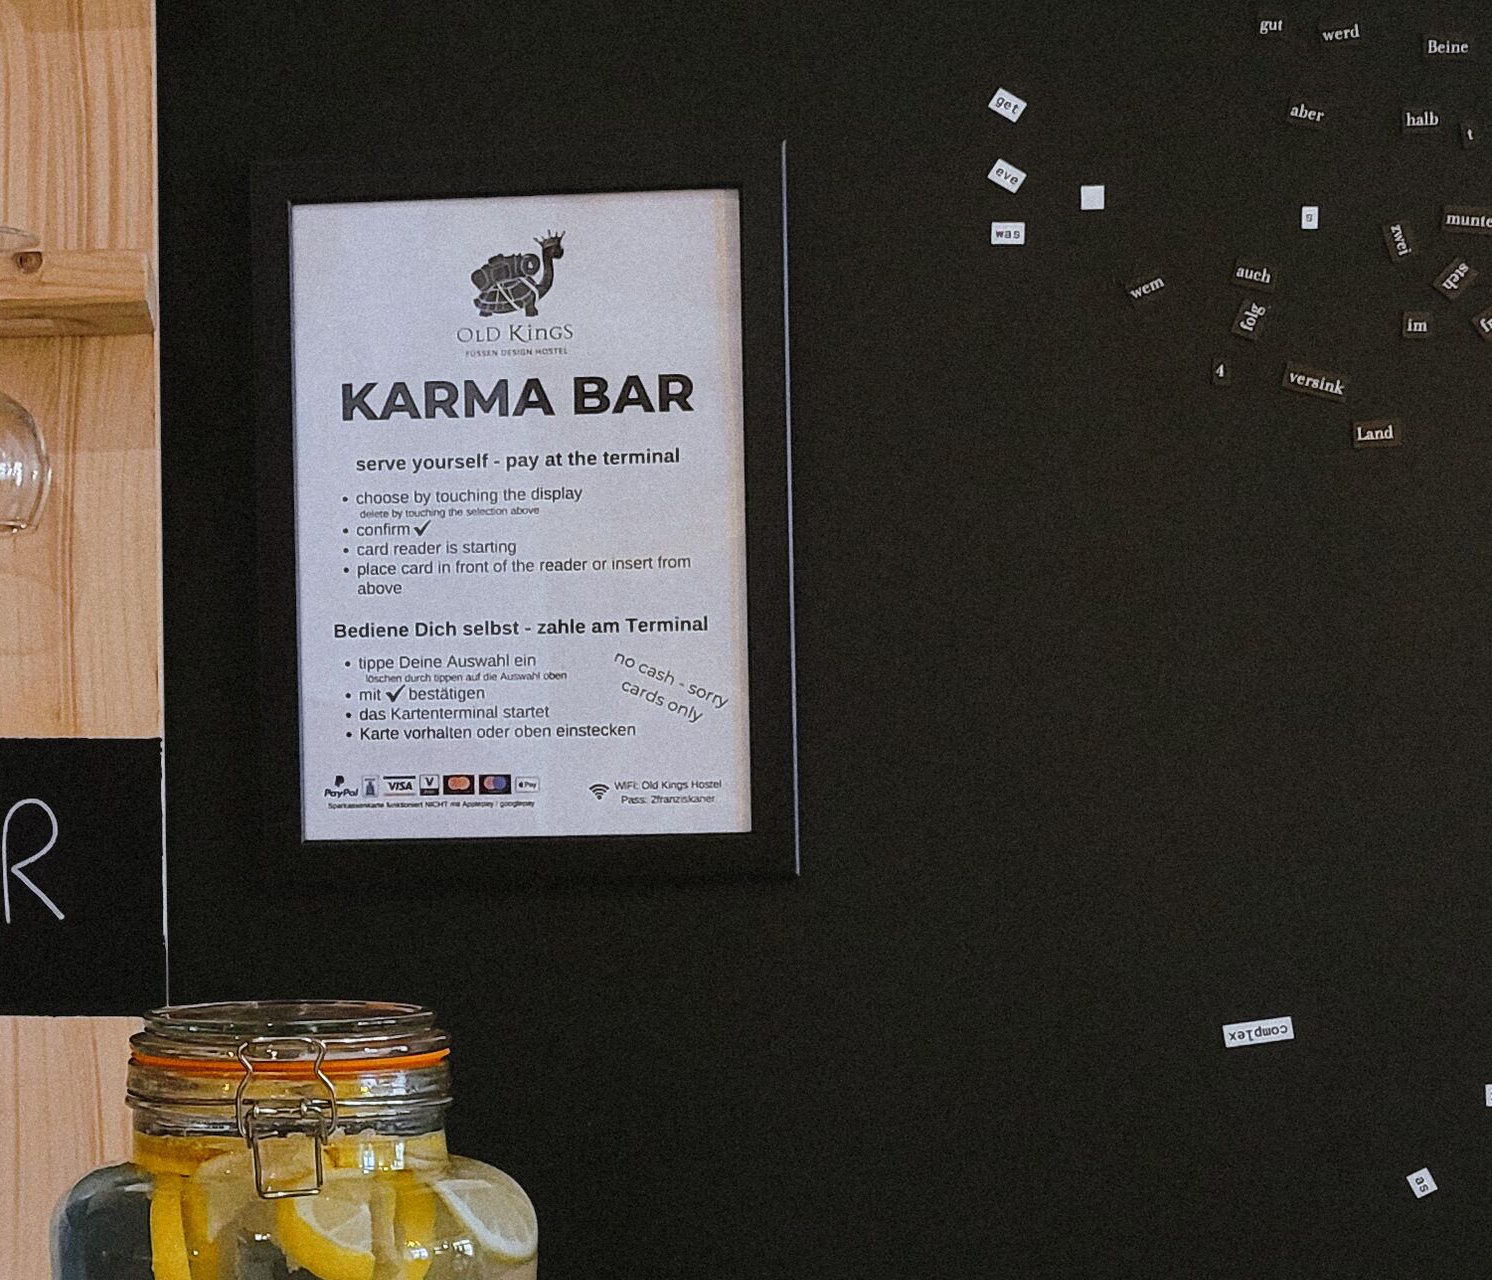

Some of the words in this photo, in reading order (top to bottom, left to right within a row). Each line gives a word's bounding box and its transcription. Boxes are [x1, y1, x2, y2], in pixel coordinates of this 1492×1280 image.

[1260, 20, 1282, 34] gut
[1323, 24, 1359, 40] werd
[1428, 40, 1468, 53] Beine
[995, 96, 1020, 115] get
[1290, 104, 1324, 121] aber
[1407, 112, 1438, 126] halb
[996, 168, 1018, 184] eve
[996, 231, 1020, 239] was
[1237, 268, 1270, 283] auch
[1130, 278, 1164, 298] wem
[1240, 304, 1265, 330] folg
[1408, 319, 1426, 331] im
[1290, 373, 1344, 394] versink
[342, 377, 556, 421] KARMA
[573, 374, 694, 415] BAR
[1358, 425, 1393, 440] Land
[356, 459, 406, 471] serve
[412, 453, 488, 474] yourself
[506, 455, 539, 472] pay
[545, 452, 563, 467] at
[568, 450, 597, 466] the
[603, 447, 679, 465] terminal
[356, 491, 409, 505] choose
[414, 489, 431, 505] by
[436, 488, 498, 505] touching
[503, 488, 526, 501] the
[531, 486, 583, 503] display
[357, 522, 410, 536] confirm
[357, 542, 388, 556] card
[393, 541, 442, 556] reader
[446, 541, 458, 554] is
[462, 540, 516, 556] starting
[357, 562, 396, 579] place
[401, 560, 433, 575] card
[438, 560, 450, 574] in
[456, 560, 489, 573] front
[493, 559, 508, 573] of
[512, 559, 534, 572] the
[540, 558, 588, 571] reader
[592, 560, 607, 571] or
[612, 557, 653, 570] insert
[658, 555, 691, 569] from
[358, 581, 402, 595] above
[334, 622, 409, 638] Bediene
[415, 621, 457, 637] Dich
[463, 620, 519, 636] selbst
[537, 618, 586, 634] zahle
[592, 621, 619, 633] am
[625, 615, 708, 633] Terminal
[359, 656, 394, 673] tippe
[399, 655, 442, 669] Deine
[447, 653, 509, 668] Auswahl
[514, 654, 536, 667] ein
[614, 653, 635, 668] no
[639, 664, 674, 685] cash
[687, 684, 729, 708] sorry
[360, 688, 381, 701] mit
[408, 685, 485, 702] bestätigen
[622, 681, 665, 706] cards
[668, 701, 703, 723] only
[359, 708, 386, 721] das
[391, 705, 498, 721] Kartenterminal
[503, 706, 549, 718] startet
[360, 727, 399, 740] Karte
[403, 726, 472, 740] vorhalten
[477, 725, 510, 738] oder
[514, 725, 551, 738] oben
[556, 723, 636, 737] einstecken
[1229, 1025, 1288, 1041] complex
[1414, 1175, 1429, 1193] as
